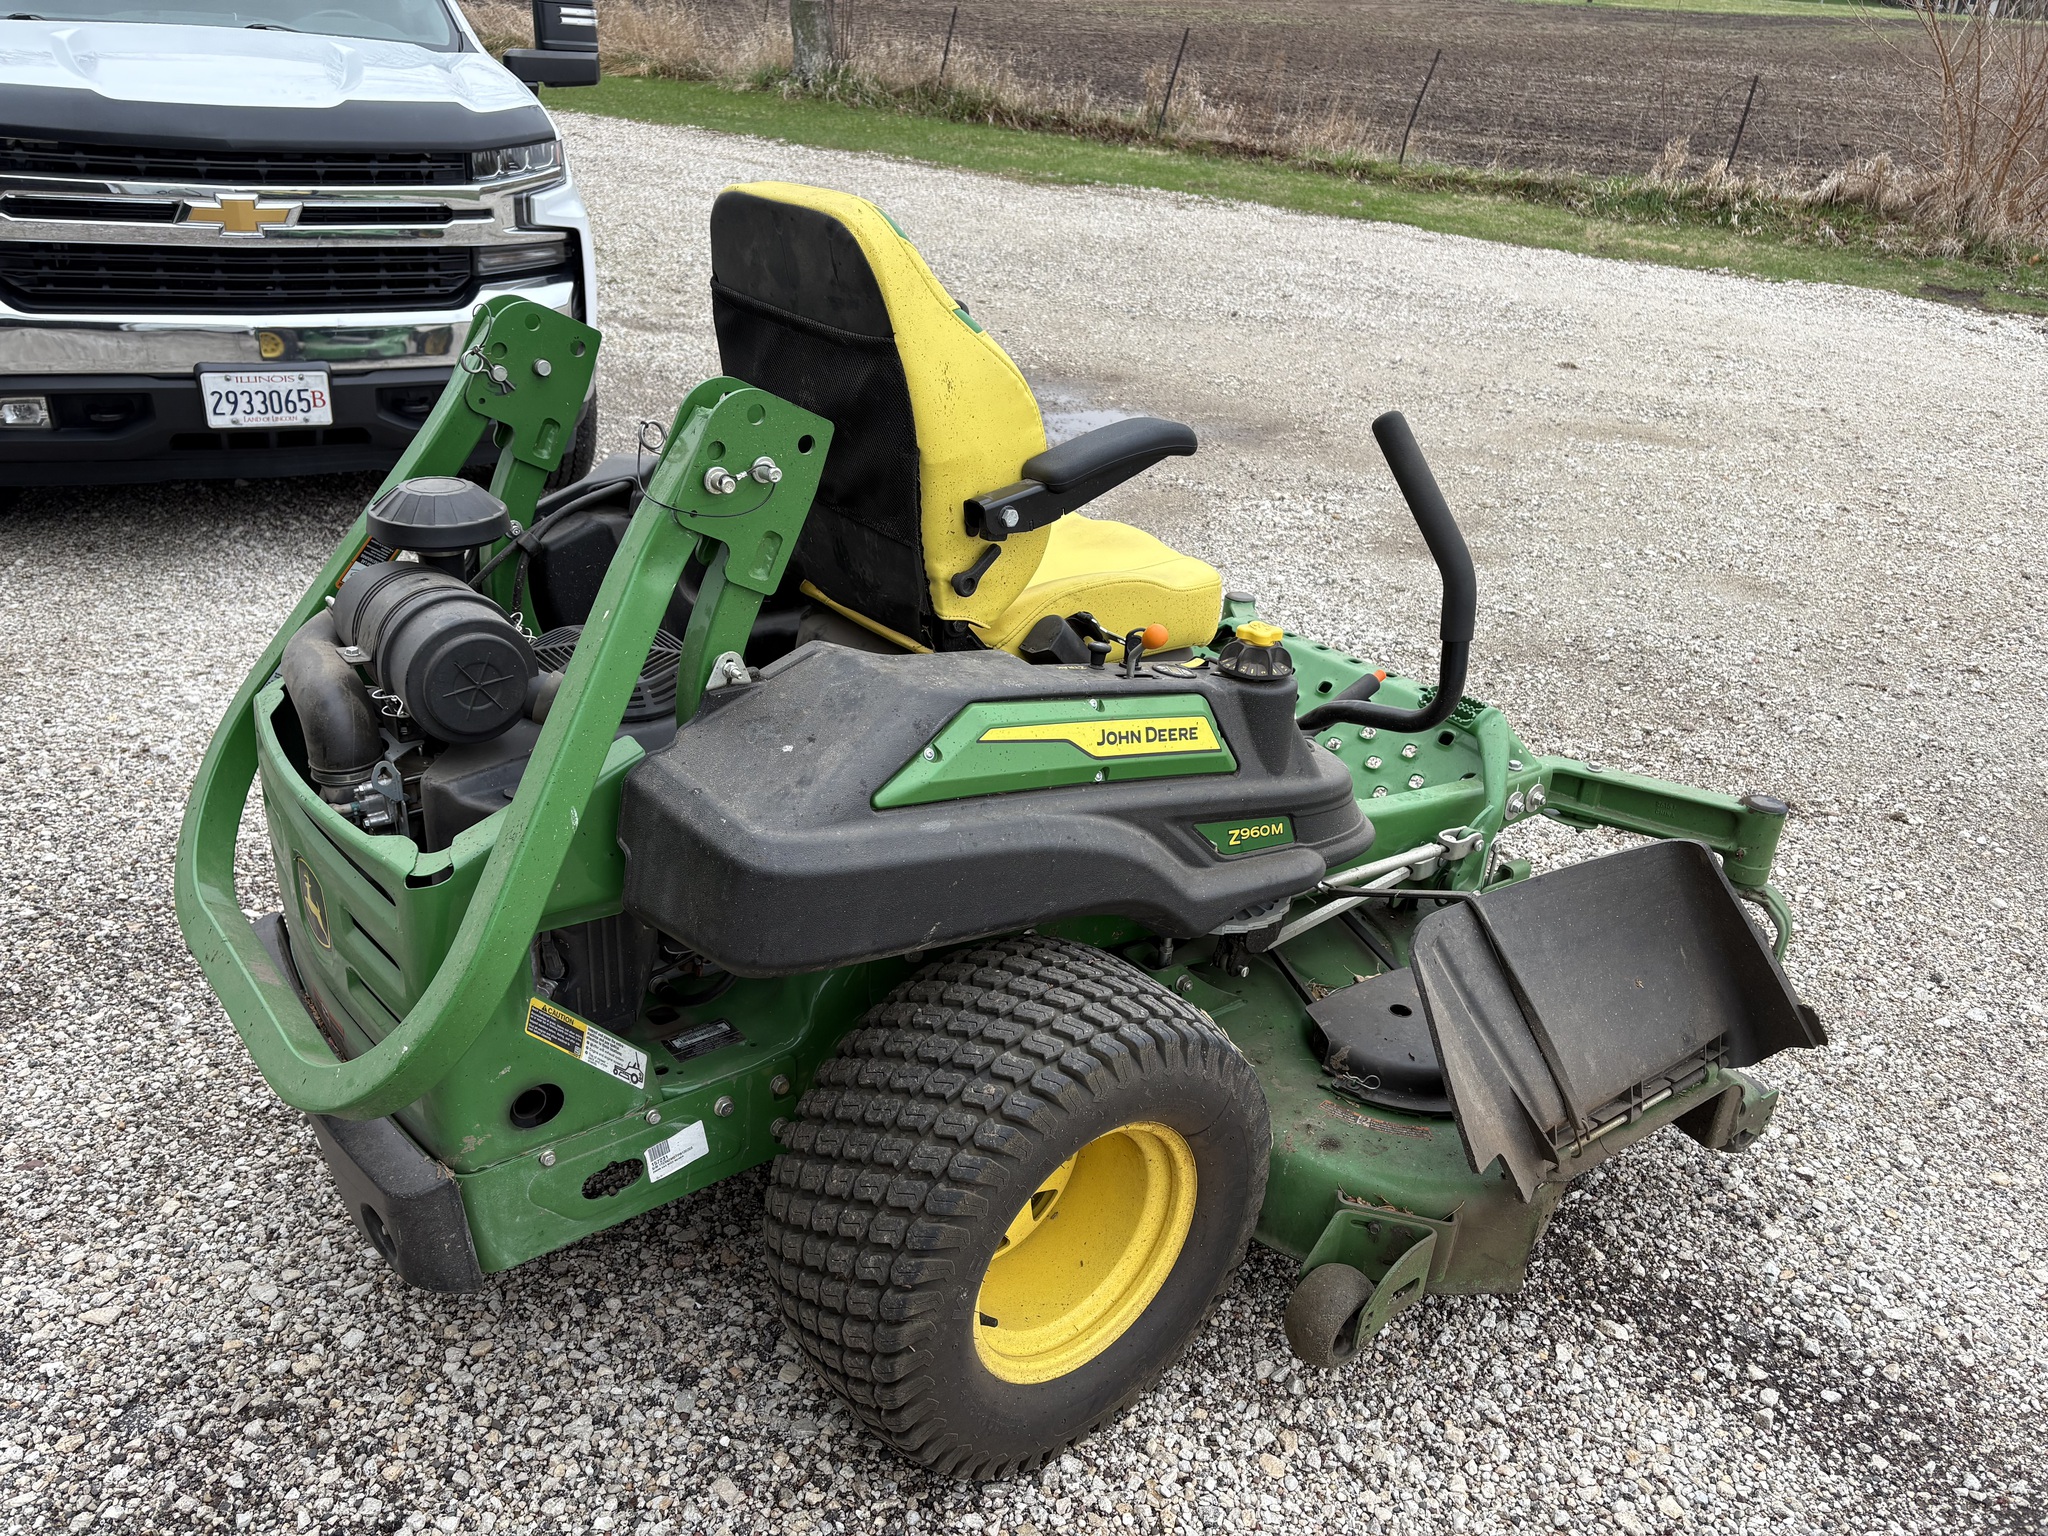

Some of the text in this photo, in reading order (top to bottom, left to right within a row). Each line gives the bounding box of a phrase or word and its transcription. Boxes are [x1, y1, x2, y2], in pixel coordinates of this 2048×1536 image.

[235, 375, 295, 383] ILLINOIS
[1096, 726, 1199, 746] JOHN DEERE
[1228, 822, 1284, 846] Z960M
[548, 1007, 575, 1026] CAUTION
